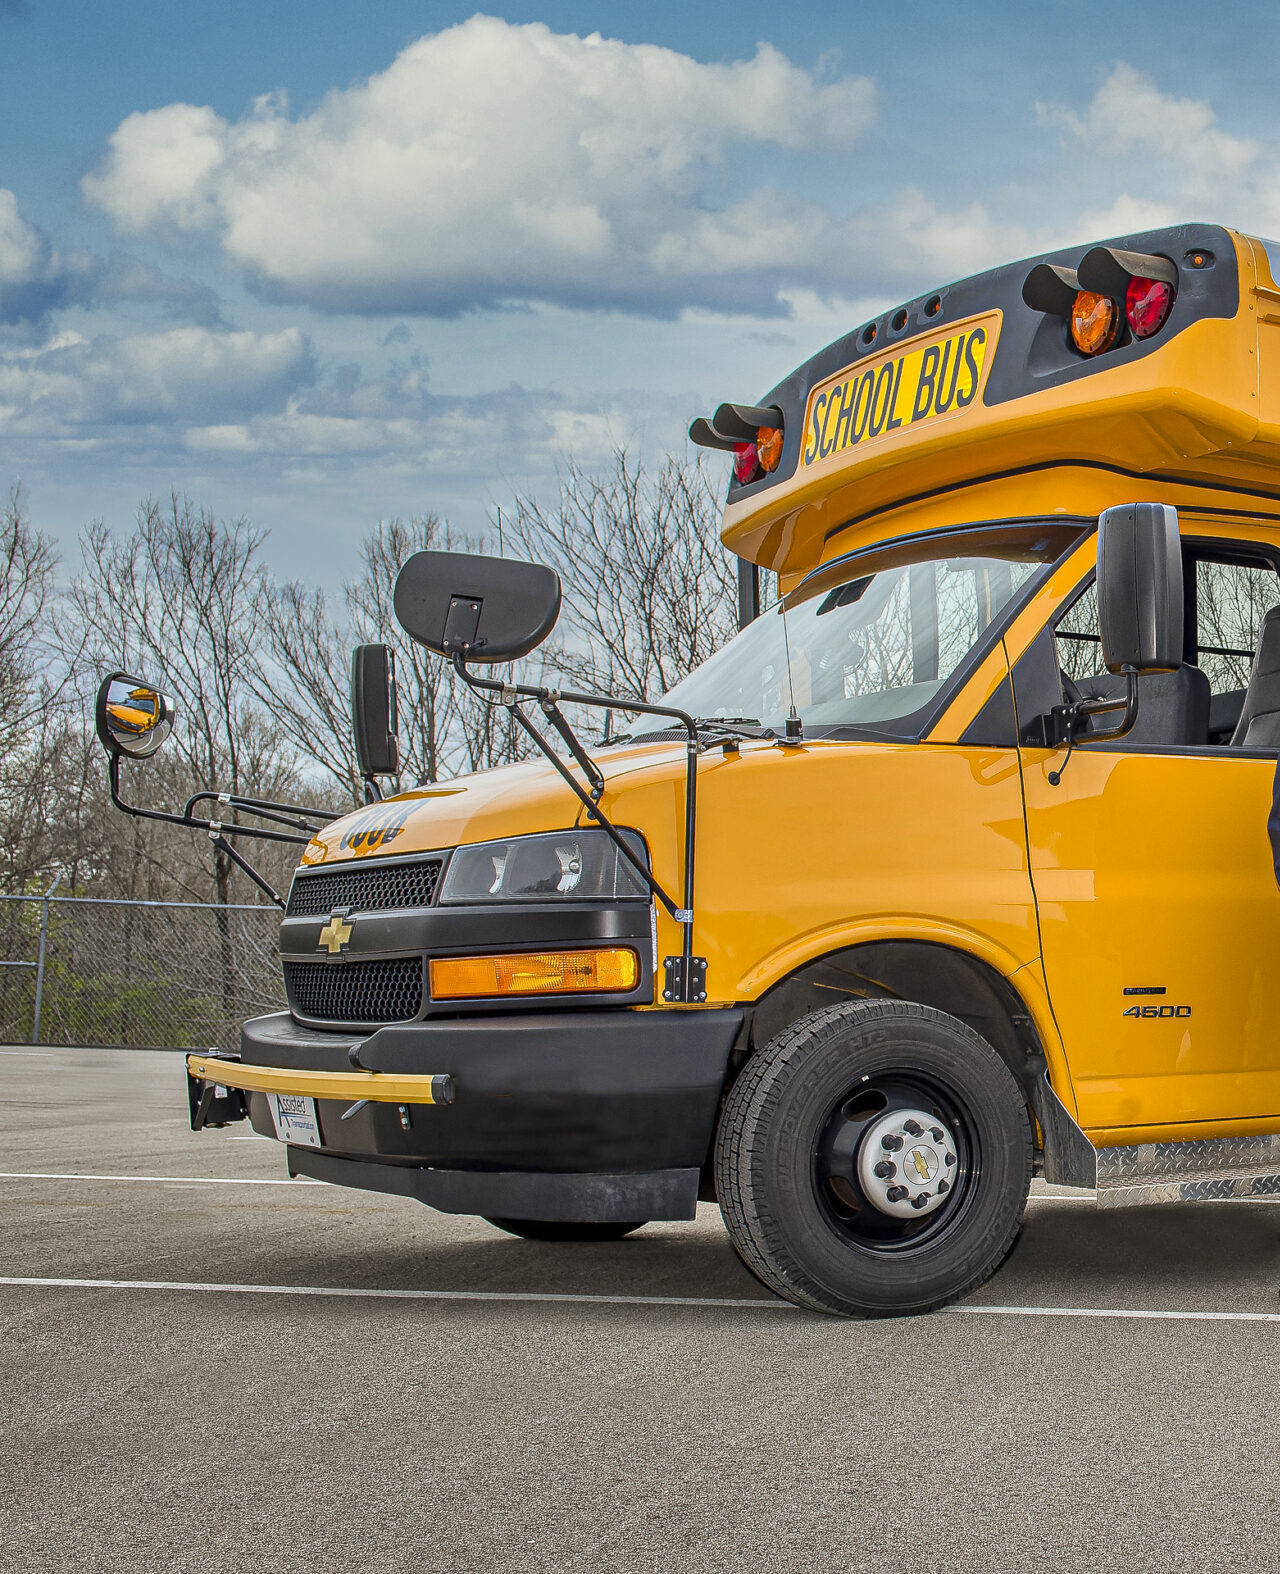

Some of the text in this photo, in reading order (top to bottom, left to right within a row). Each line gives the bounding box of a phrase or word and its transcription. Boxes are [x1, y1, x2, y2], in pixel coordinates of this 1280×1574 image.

[804, 327, 986, 466] SCHOOL BUS
[1122, 1005, 1192, 1018] 4500
